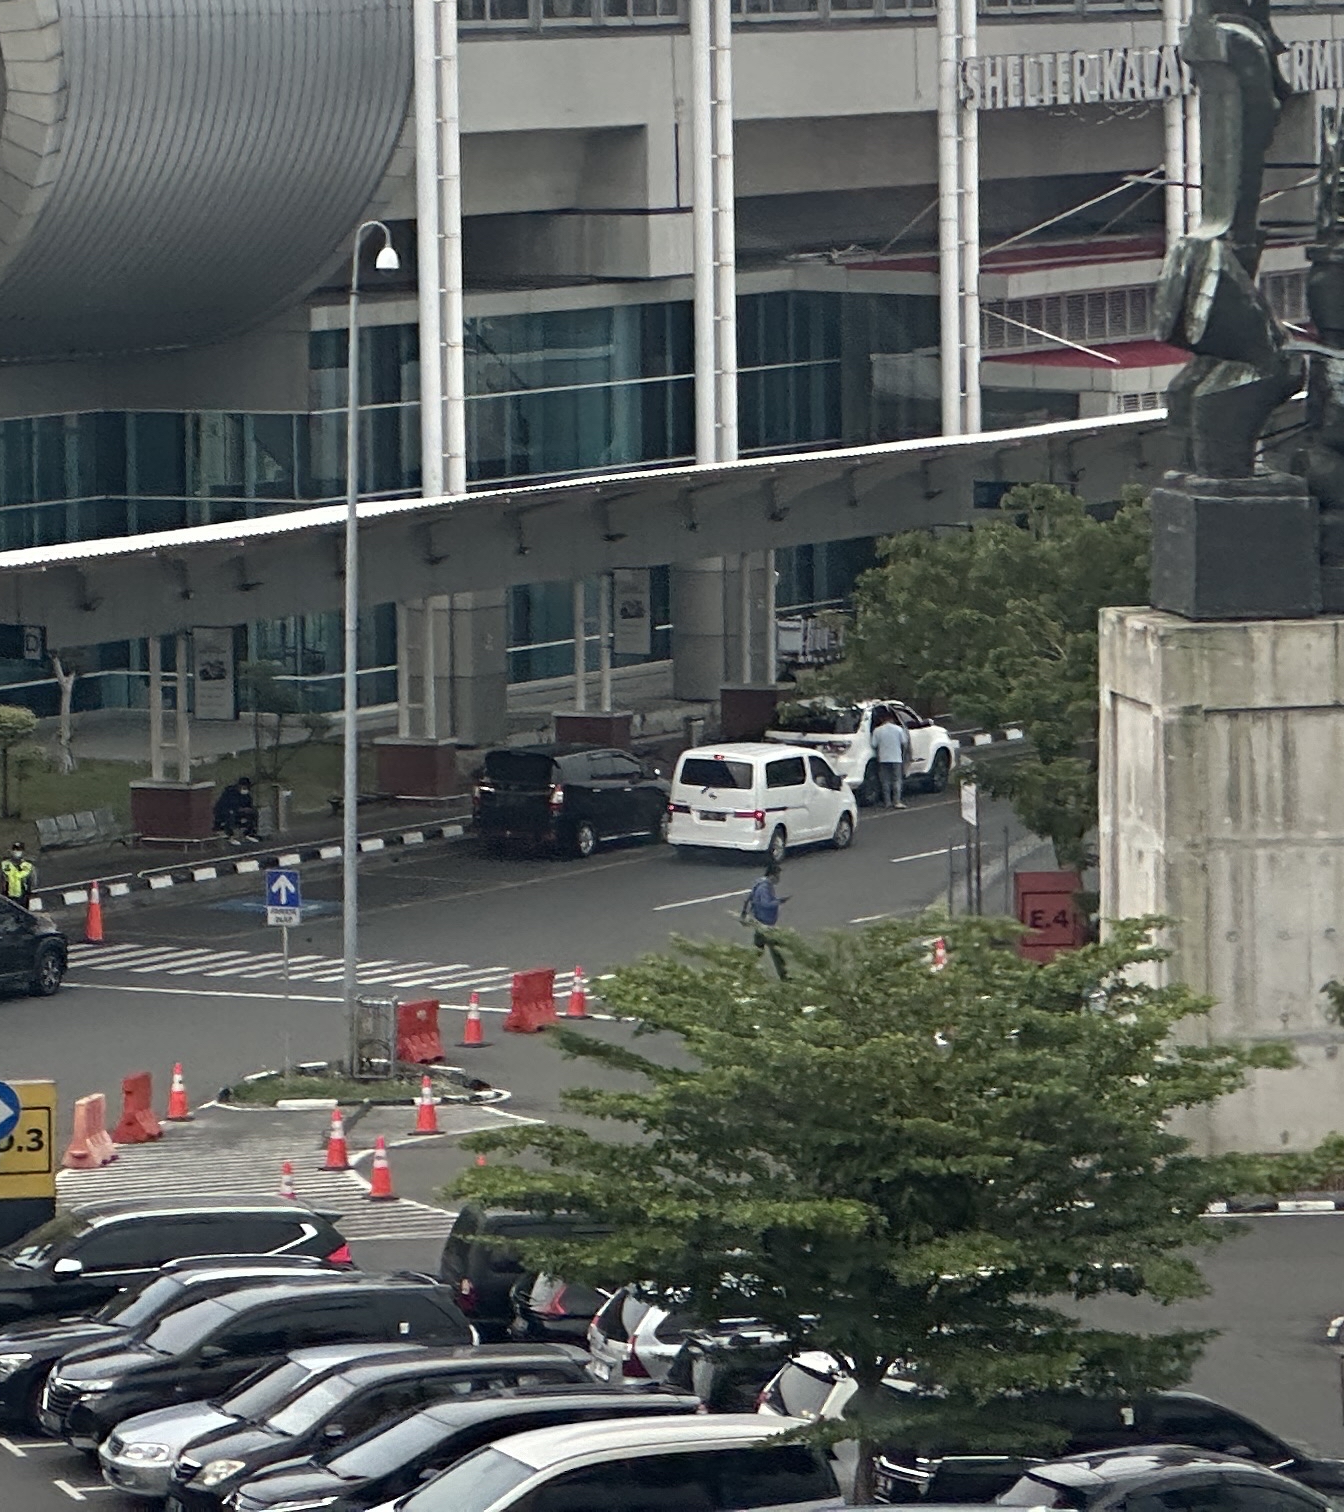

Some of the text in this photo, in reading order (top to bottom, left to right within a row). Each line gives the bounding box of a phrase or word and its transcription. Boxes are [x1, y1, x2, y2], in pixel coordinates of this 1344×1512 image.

[964, 49, 1091, 111] SHELTER
[1102, 43, 1194, 102] KALA
[1029, 909, 1069, 929] E.4
